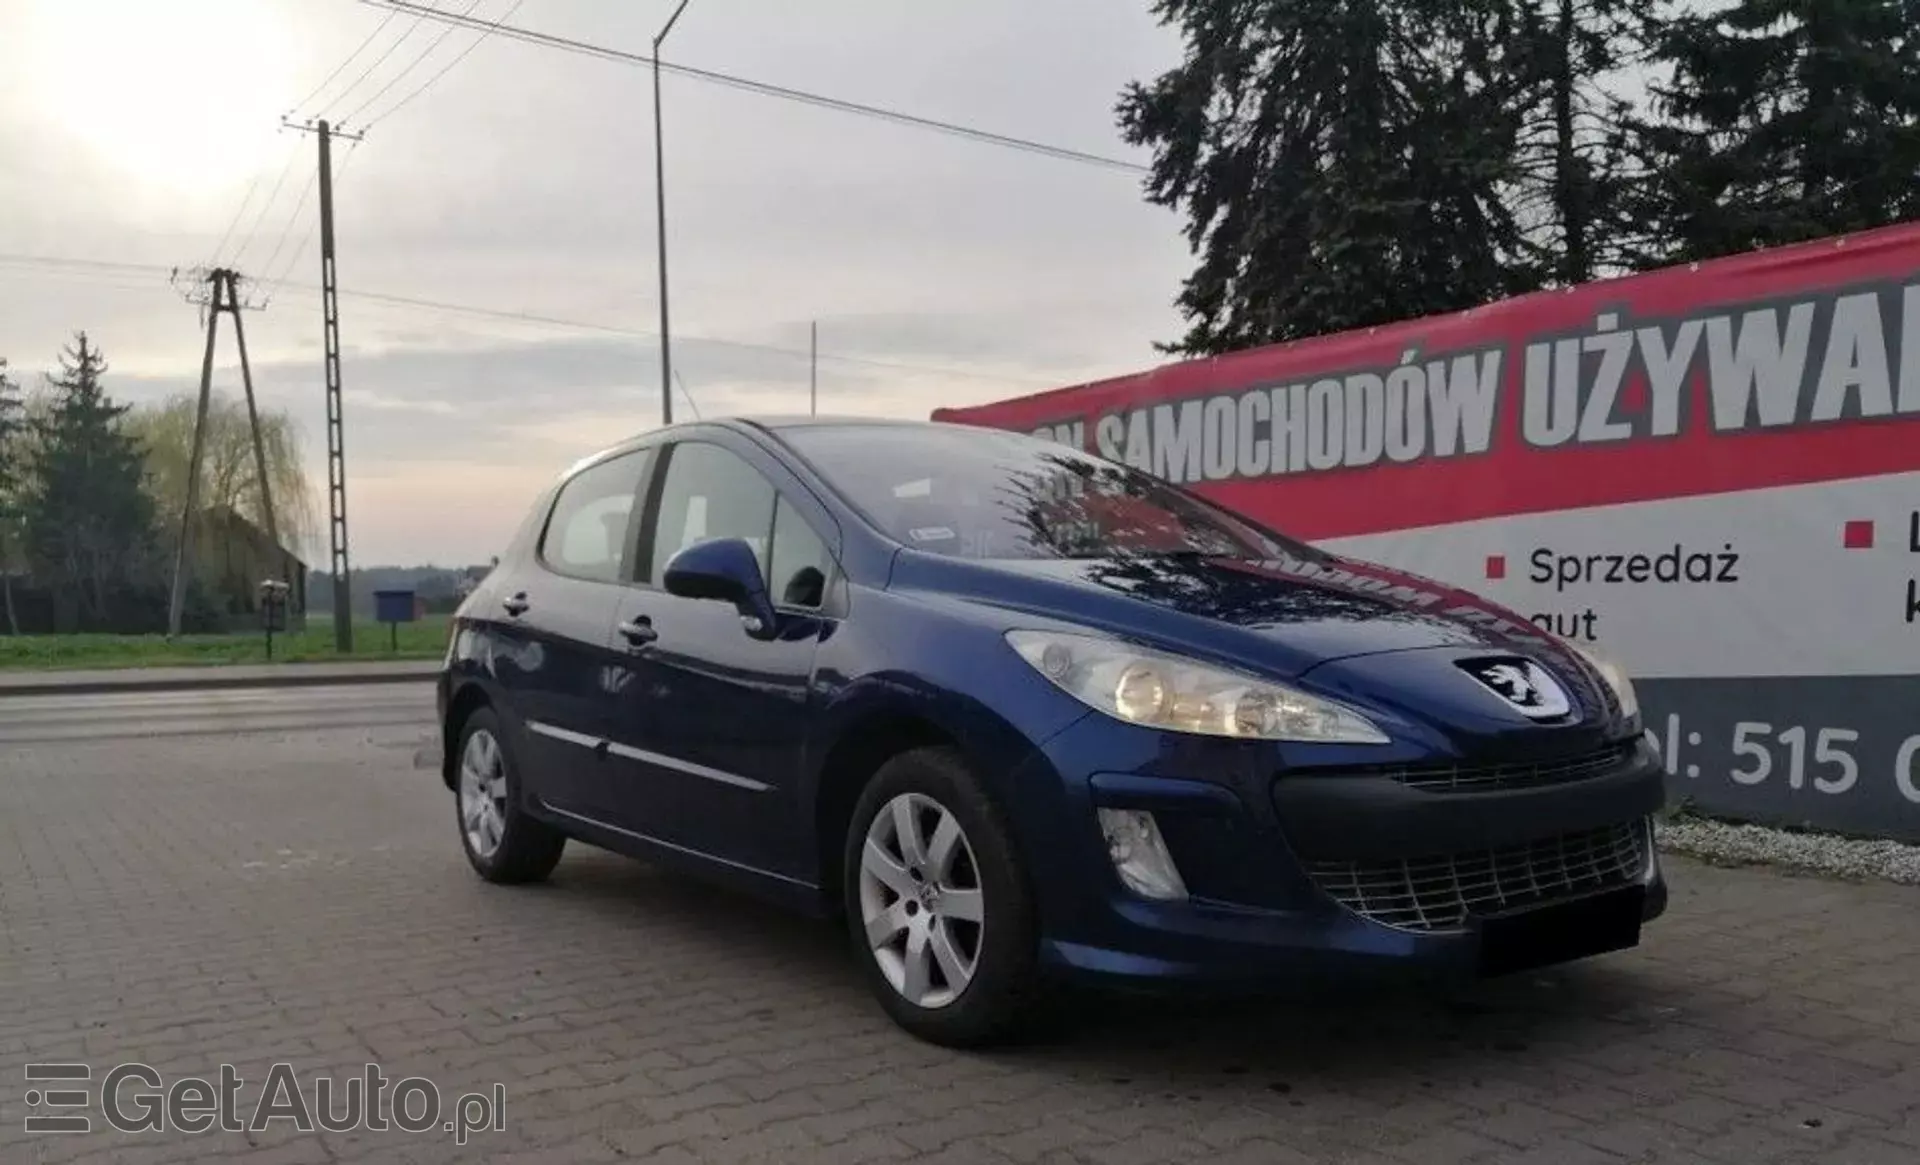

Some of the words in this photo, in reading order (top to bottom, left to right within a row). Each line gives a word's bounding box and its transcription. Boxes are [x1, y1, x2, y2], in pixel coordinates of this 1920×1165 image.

[1096, 349, 1502, 484] SAMOCHODÓW
[1530, 543, 1739, 592] Sprzedaż
[1643, 713, 1702, 779] l:
[1730, 721, 1859, 794] 515
